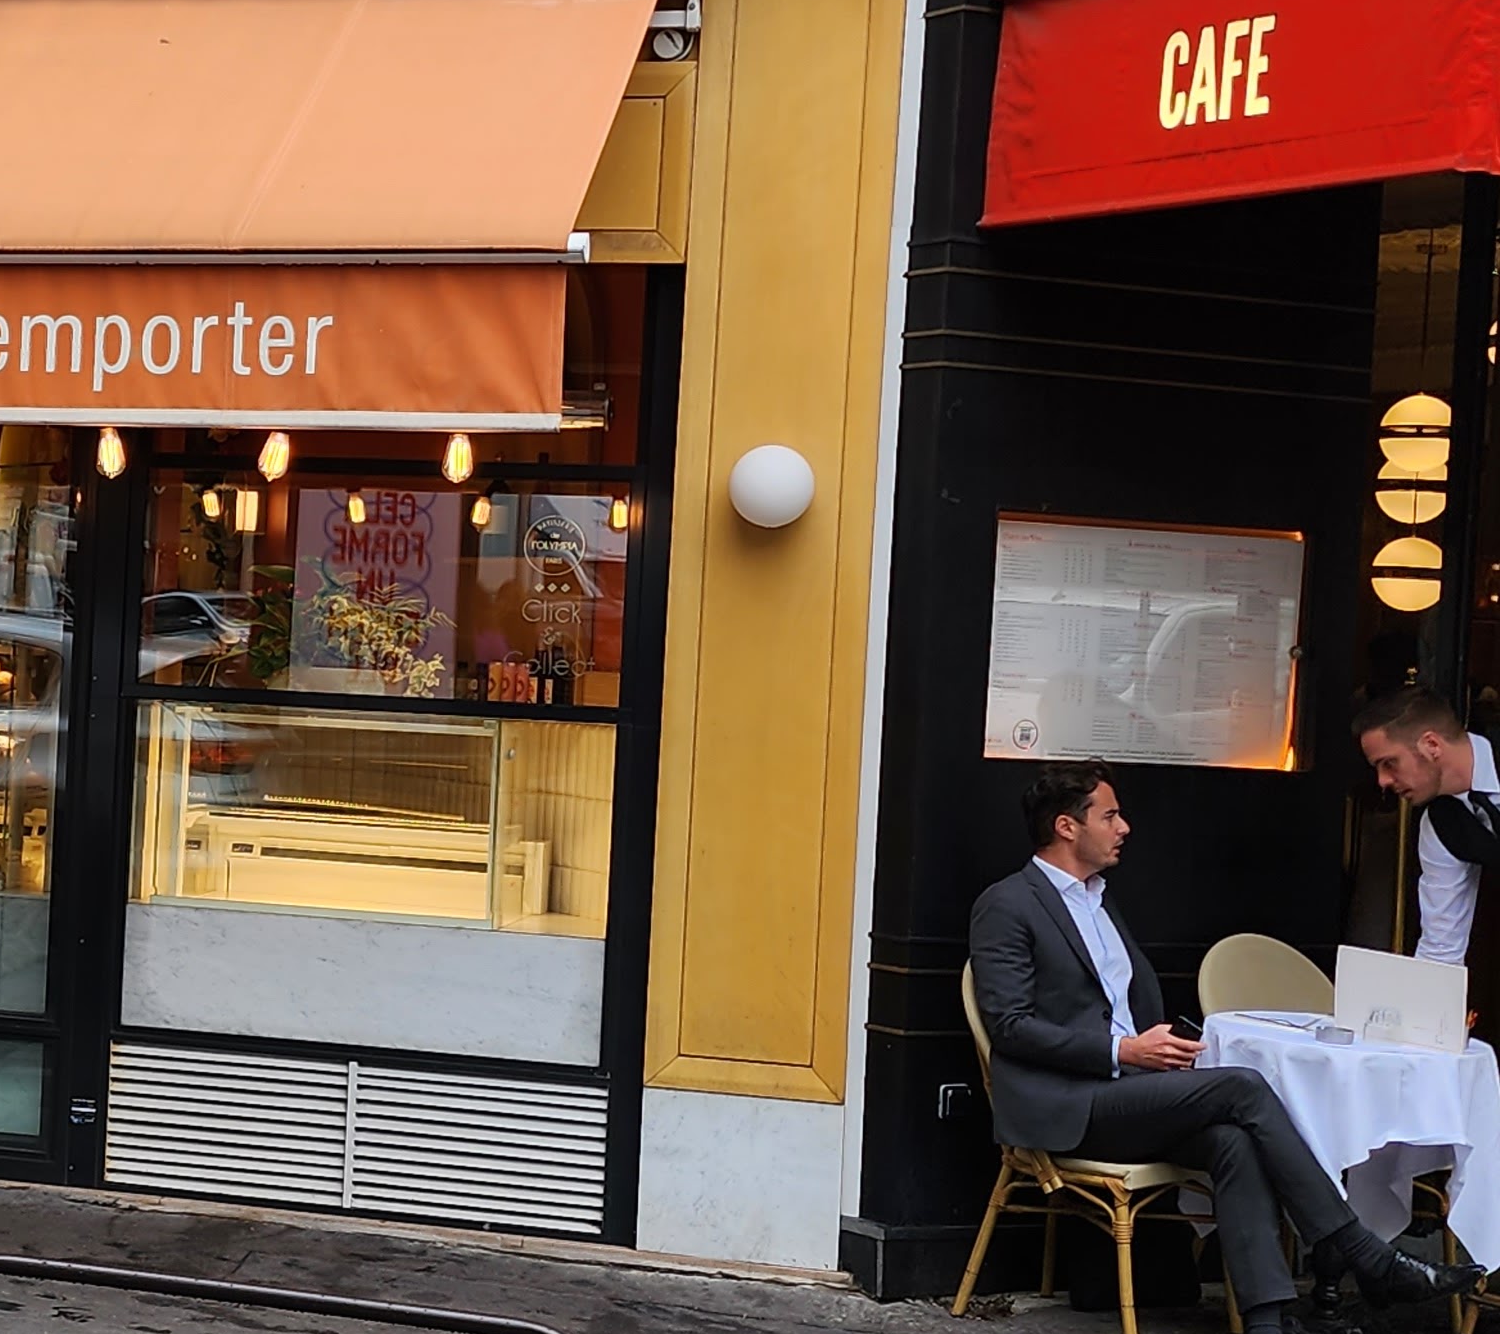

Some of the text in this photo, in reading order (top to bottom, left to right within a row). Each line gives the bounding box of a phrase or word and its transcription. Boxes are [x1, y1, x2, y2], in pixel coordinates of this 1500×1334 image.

[1159, 14, 1276, 130] CAFE
[521, 599, 581, 624] Click
[542, 626, 557, 645] &
